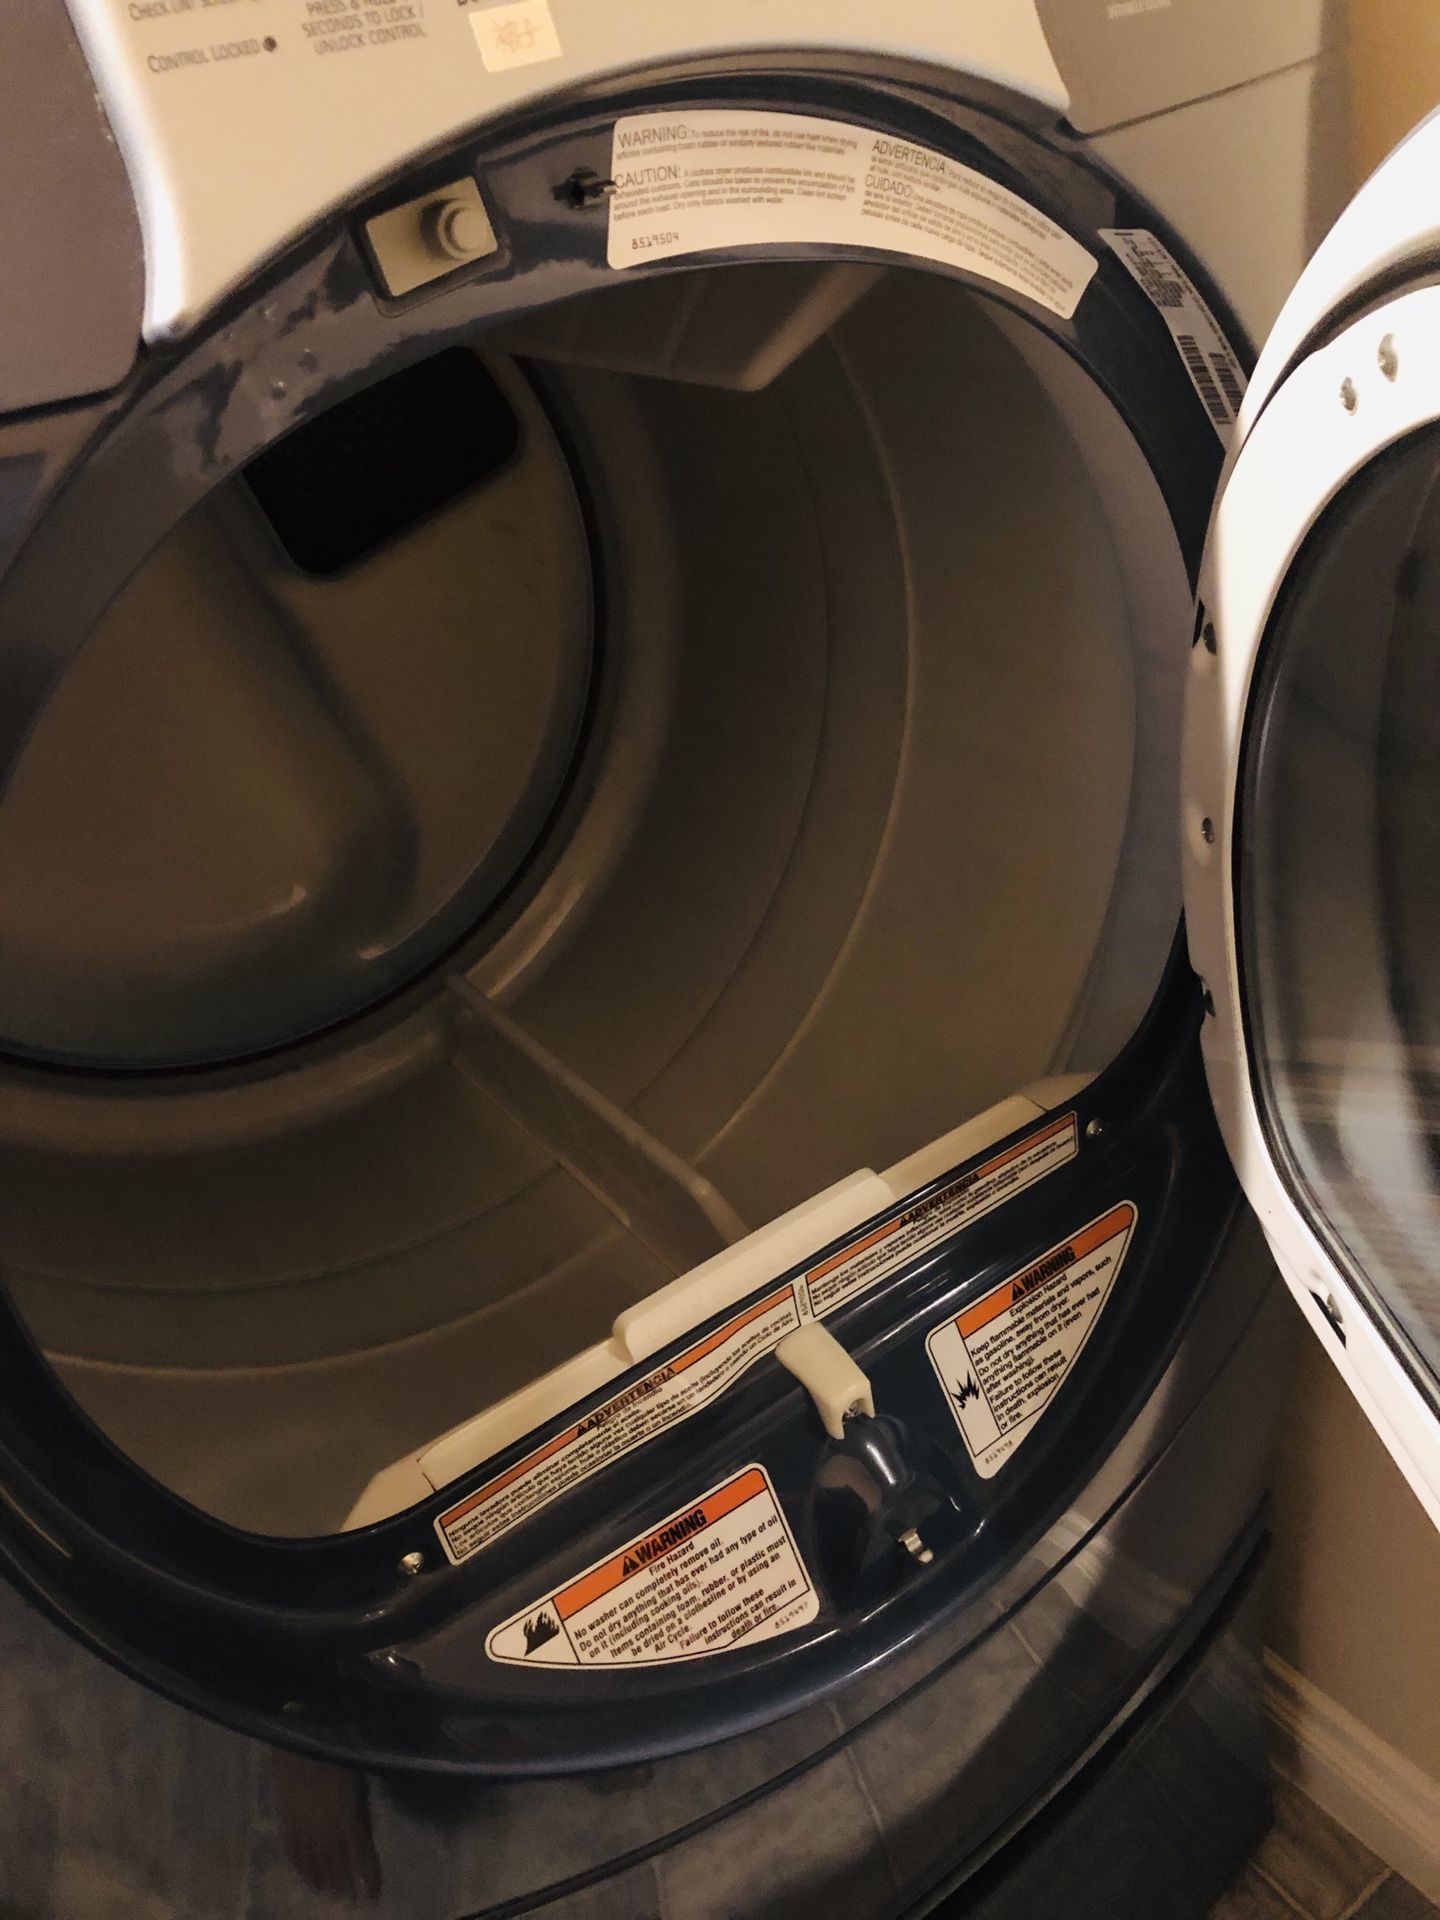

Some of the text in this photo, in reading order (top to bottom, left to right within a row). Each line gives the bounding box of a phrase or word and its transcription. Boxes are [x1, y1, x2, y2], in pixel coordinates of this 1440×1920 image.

[363, 10, 381, 25] TO
[384, 5, 416, 23] LOCK
[367, 23, 428, 45] CONTROL
[1009, 1273, 1067, 1317] Explosion Hazard
[1021, 1245, 1077, 1288] WARNING
[970, 1256, 1112, 1357] Keep flammable materials and vapors, such
[975, 1297, 1068, 1366] as gasoline, away from dryer.
[978, 1287, 1100, 1376] Do not dry anything that has ever had
[982, 1311, 1082, 1385] anything flammable on it (even
[989, 1349, 1062, 1404] Failure to follow these
[993, 1356, 1067, 1412] instructions can result
[996, 1373, 1061, 1421] in death, explosion
[1001, 1412, 1022, 1430] or fire.
[635, 1508, 707, 1565] WARNING
[649, 1541, 694, 1576] Fire Hazard
[574, 1628, 587, 1640] No
[588, 1607, 617, 1631] washer
[619, 1597, 634, 1610] can
[635, 1567, 679, 1600] completely
[680, 1547, 709, 1570] remove
[579, 1515, 778, 1651] Do not dry anything that has ever had any type of oil
[610, 1536, 786, 1658] Items containing foam, rubber, or plastic must
[631, 1553, 780, 1656] be dried on a clothesline or by using an
[589, 1647, 600, 1658] on
[601, 1640, 608, 1649] it
[609, 1613, 650, 1645] (including
[650, 1592, 682, 1616] cooking
[655, 1625, 690, 1653] Air Cycle.
[680, 1589, 764, 1649] Failure to follow these
[704, 1579, 796, 1645] instructions can result in
[731, 1604, 781, 1639] death or fire.
